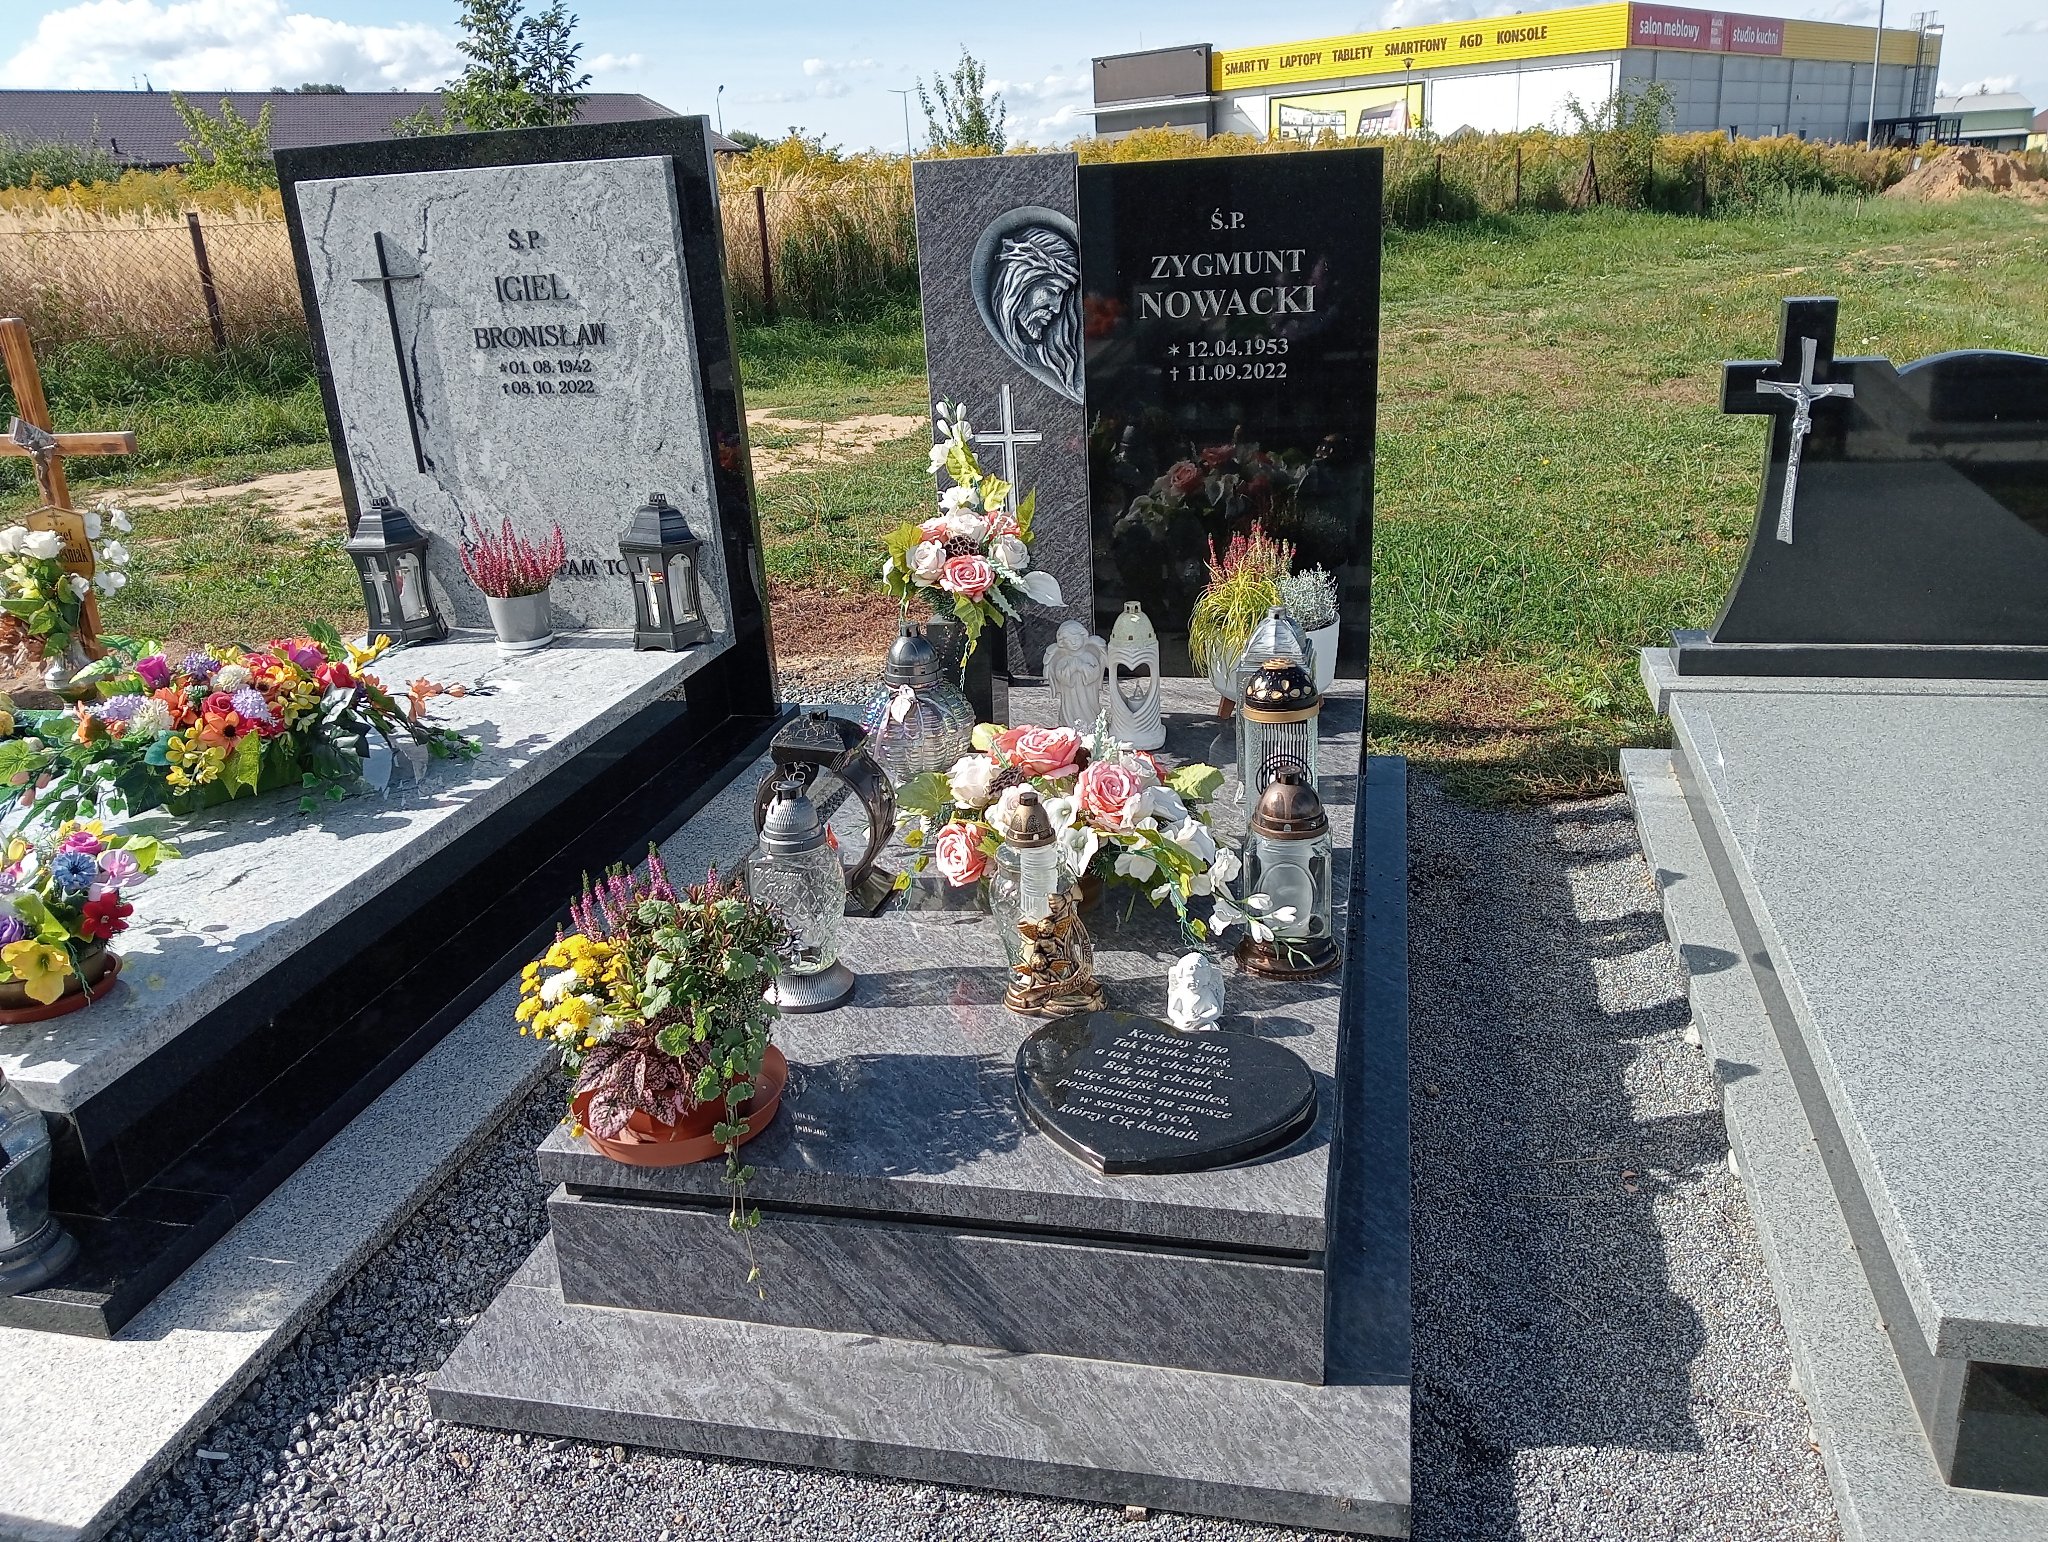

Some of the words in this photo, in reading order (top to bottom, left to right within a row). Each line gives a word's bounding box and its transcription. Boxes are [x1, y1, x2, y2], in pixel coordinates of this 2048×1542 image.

[1640, 16, 1662, 35] salon
[1664, 19, 1700, 42] meblowy
[1733, 26, 1755, 43] studio
[1756, 27, 1779, 45] kuchni
[1225, 60, 1255, 75] SMART
[1257, 58, 1269, 71] TV
[1280, 52, 1322, 68] LAPTOPY
[1332, 46, 1373, 62] TABLETY
[1385, 37, 1447, 56] SMARTFONY
[1459, 34, 1483, 49] AGD
[1497, 26, 1548, 44] KONSOLE
[1210, 208, 1246, 230] Ś.P.
[1150, 249, 1306, 279] ZYGMUNT
[494, 273, 570, 303] IGIEL
[1138, 285, 1317, 320] NOWACKI
[472, 322, 607, 350] BRONISŁAW
[1187, 338, 1289, 358] 12.04.1953
[1188, 362, 1287, 381] 11.09.2022
[1112, 1037, 1137, 1049] Tak
[1141, 1042, 1189, 1059] krótko
[1127, 1028, 1194, 1048] Kochany
[1197, 1041, 1229, 1054] Tato
[1107, 1049, 1131, 1060] tak
[1073, 1068, 1107, 1081] więc
[1102, 1060, 1133, 1074] Bóg
[1135, 1067, 1160, 1079] tak
[1055, 1078, 1151, 1104] pozostaniesz
[1154, 1098, 1175, 1108] na
[1177, 1103, 1233, 1120] zawsze
[1079, 1095, 1093, 1104] w
[1094, 1099, 1154, 1117] sercach
[1057, 1103, 1105, 1122] którzy
[1108, 1114, 1135, 1130] Cię
[1137, 1121, 1200, 1142] kochali.
